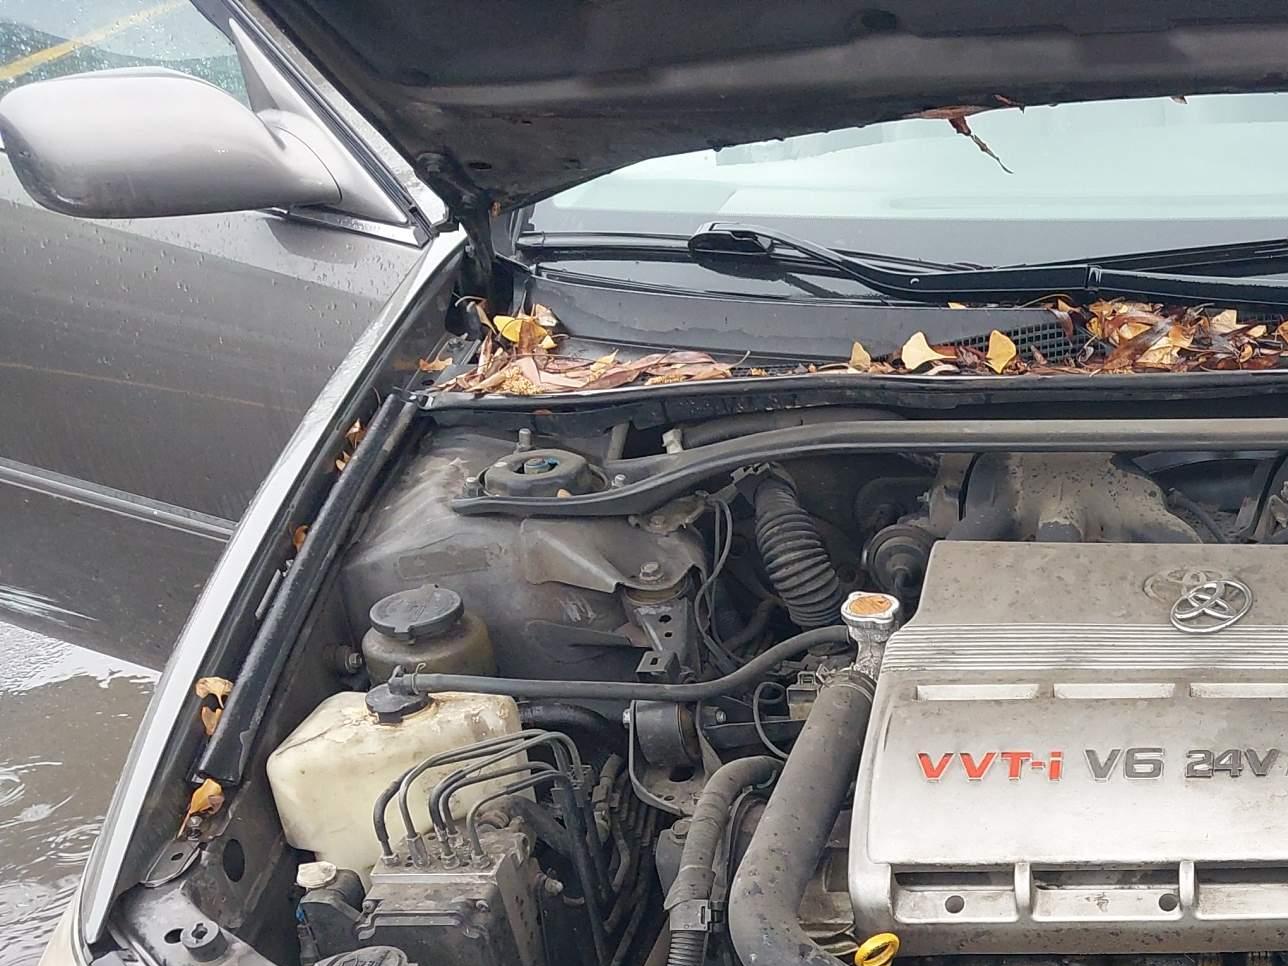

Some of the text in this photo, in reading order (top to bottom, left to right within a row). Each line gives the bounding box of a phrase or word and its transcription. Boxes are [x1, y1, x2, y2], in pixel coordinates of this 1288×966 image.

[916, 748, 1280, 783] VVT-i V6 24V
